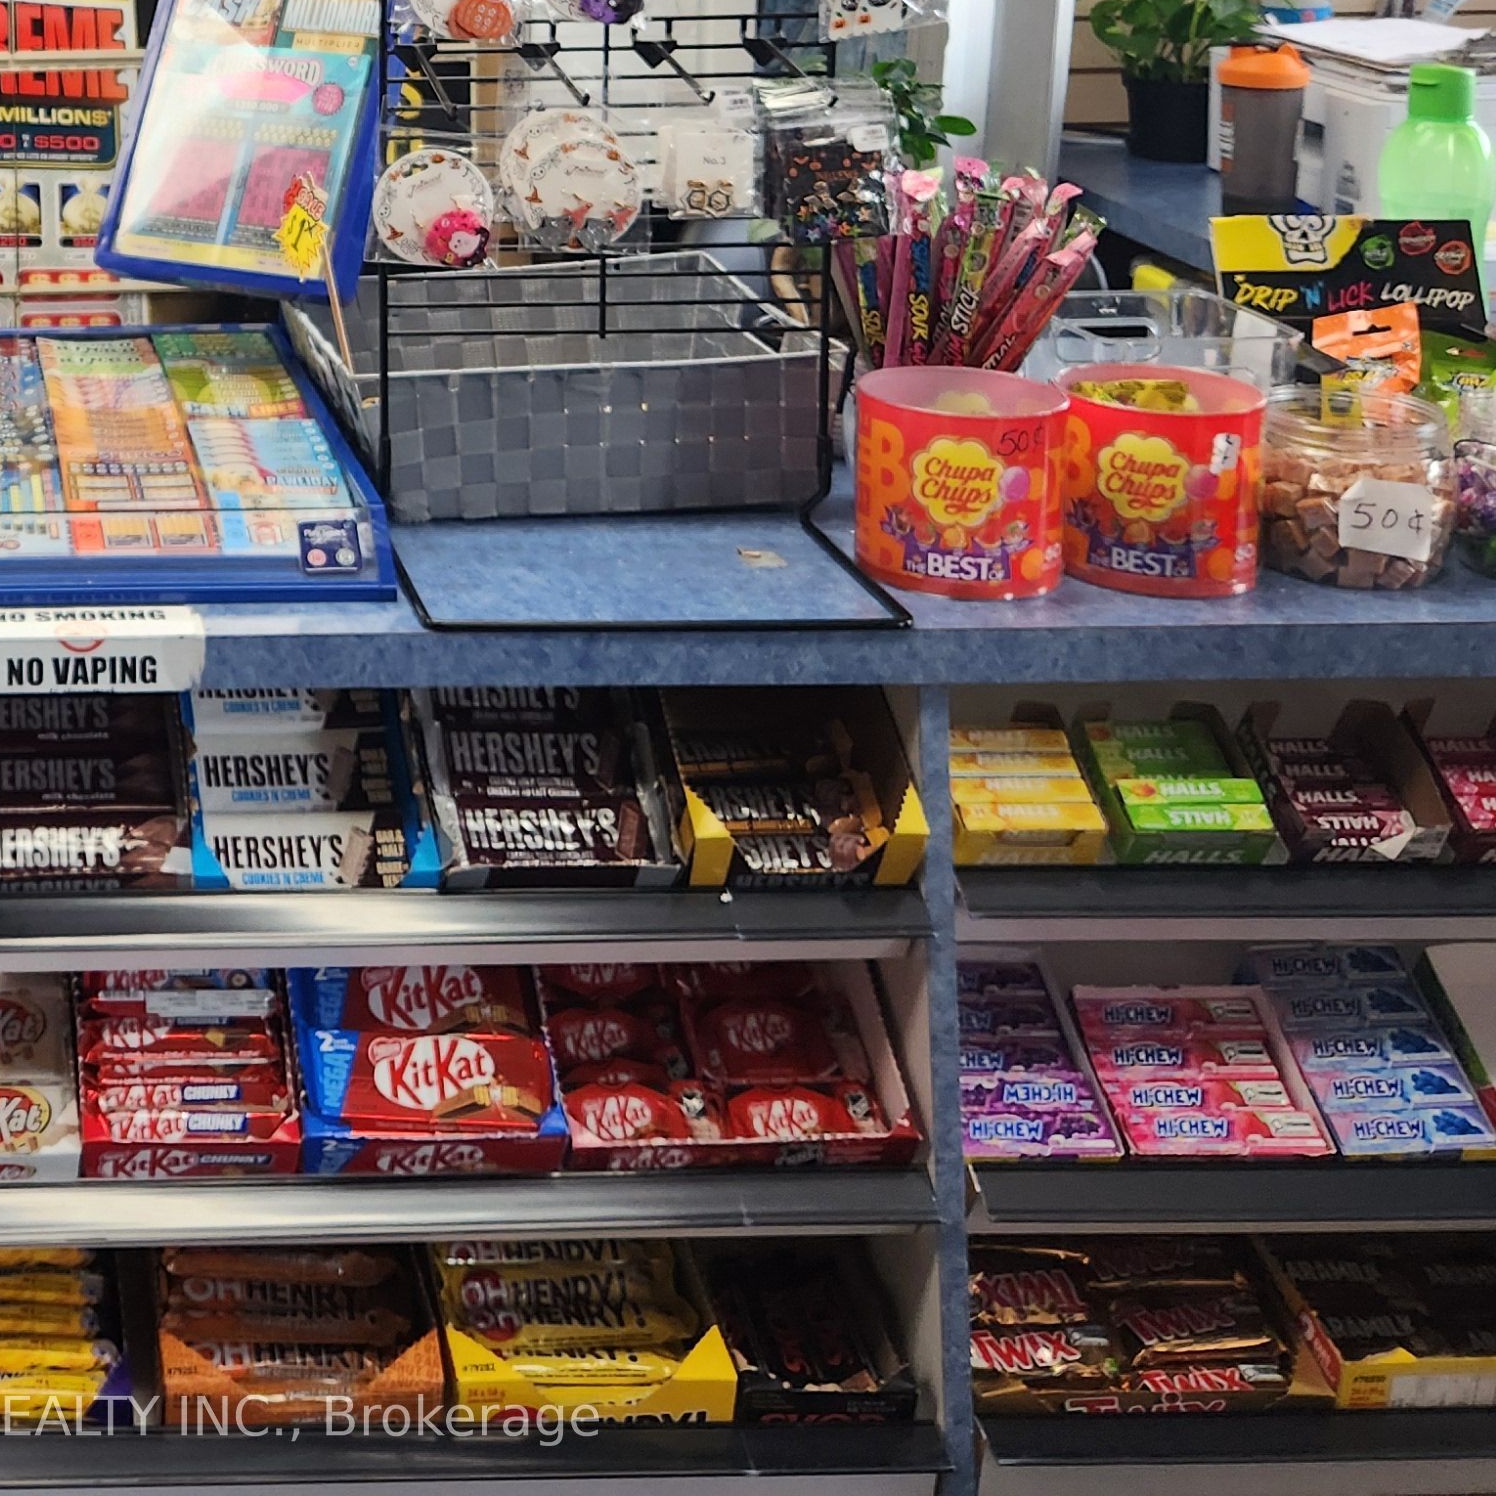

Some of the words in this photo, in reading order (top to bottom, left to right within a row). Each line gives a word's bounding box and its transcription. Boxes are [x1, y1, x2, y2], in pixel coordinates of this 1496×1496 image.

[34, 134, 100, 150] $500
[951, 283, 982, 334] STICK
[1234, 282, 1298, 312] DRIP
[1327, 281, 1375, 312] LICK
[1380, 282, 1475, 311] LOLLIPOP
[997, 424, 1045, 458] 50¢
[924, 456, 996, 484] Chupa
[1108, 449, 1182, 479] Chupa
[920, 479, 992, 513] Chups
[1105, 473, 1177, 510] Chups
[1349, 502, 1425, 536] 50¢
[927, 551, 989, 581] BEST
[35, 609, 166, 621] SMOKING
[7, 657, 44, 686] NO
[51, 655, 157, 685] VAPING
[451, 731, 600, 776] HERSHEY'S
[204, 753, 329, 787] HERSHEY'S
[1159, 782, 1224, 798] HALLS
[1297, 790, 1358, 804] HALLS
[464, 808, 619, 851] HERSHEY'S
[213, 834, 344, 869] HERSHEY'S
[1106, 1005, 1171, 1023] HI-CHEW
[1113, 1047, 1182, 1065] HI-CHEW
[184, 1085, 239, 1102] CHUNKY
[1132, 1088, 1201, 1106] HI-CHEW
[1333, 1079, 1402, 1098] HI-CHEW
[188, 1113, 244, 1133] CHUNKY
[969, 1120, 1043, 1140] HI-CHEW
[1157, 1119, 1228, 1137] HI-CHEW
[1353, 1121, 1424, 1138] HI-CHEW
[462, 1281, 507, 1307] OH
[512, 1270, 627, 1307] HENRY!
